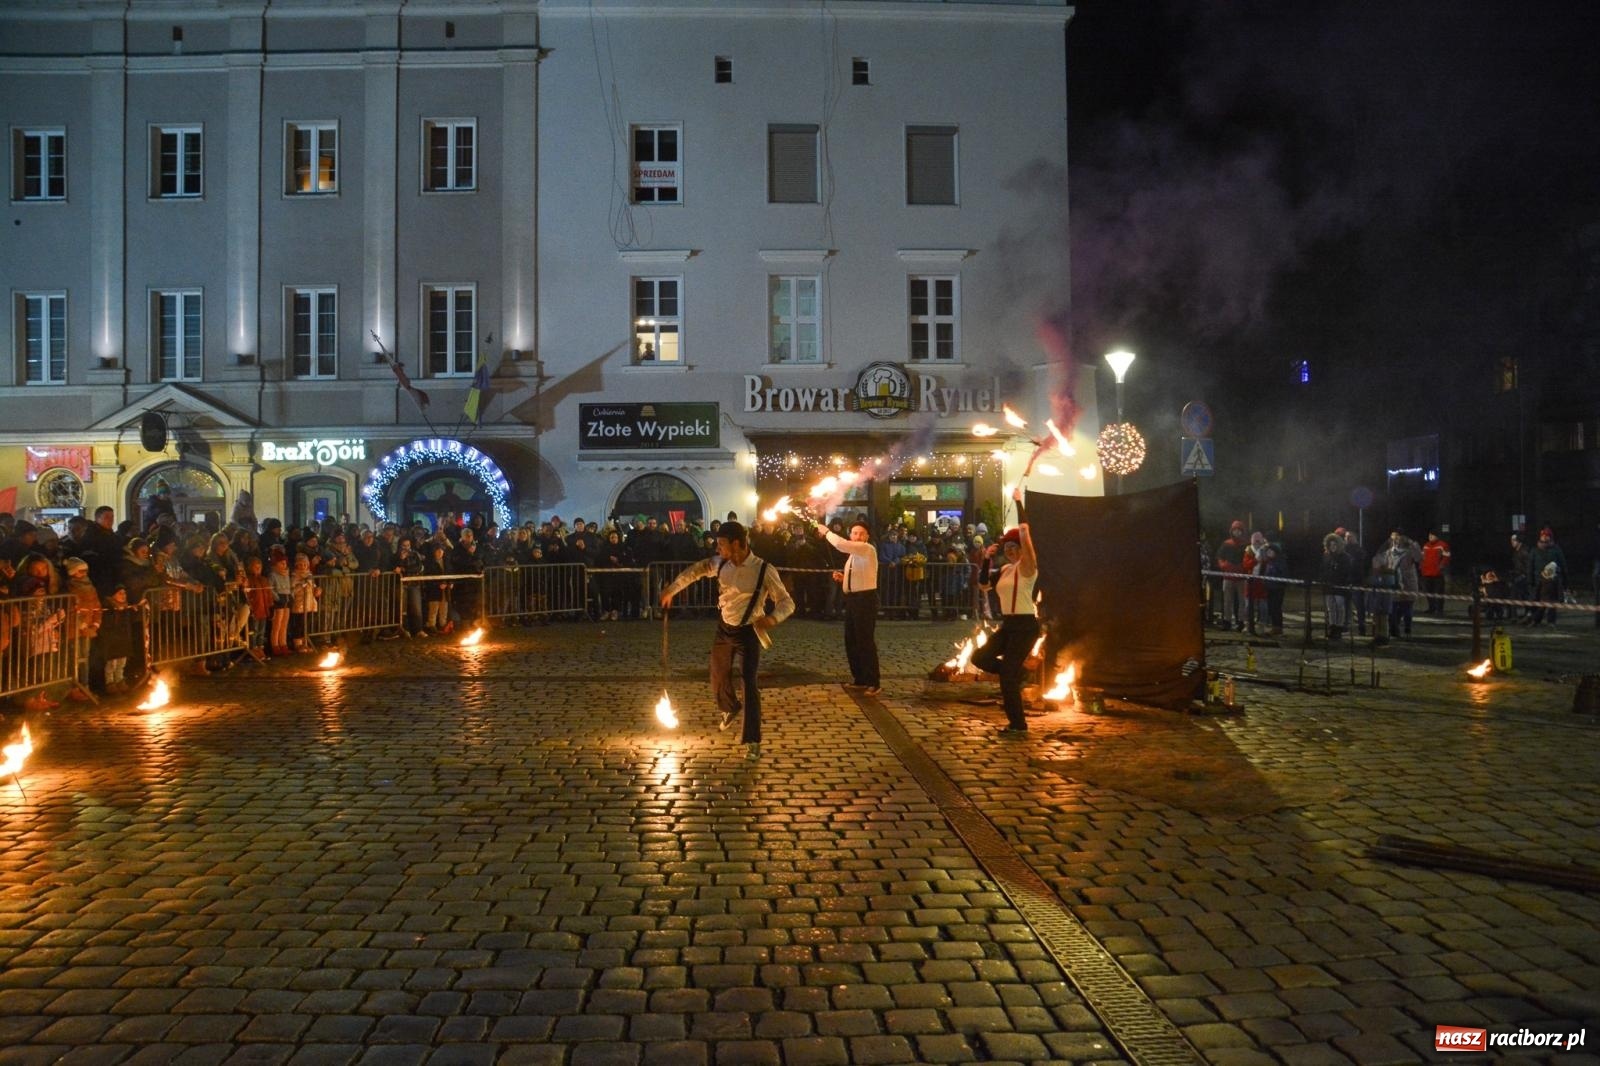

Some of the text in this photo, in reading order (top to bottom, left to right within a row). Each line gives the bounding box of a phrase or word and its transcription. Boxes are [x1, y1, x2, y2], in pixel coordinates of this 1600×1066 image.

[633, 169, 675, 178] SPRZEDAM
[743, 374, 849, 413] Browar
[587, 419, 711, 441] Złote Wypieki
